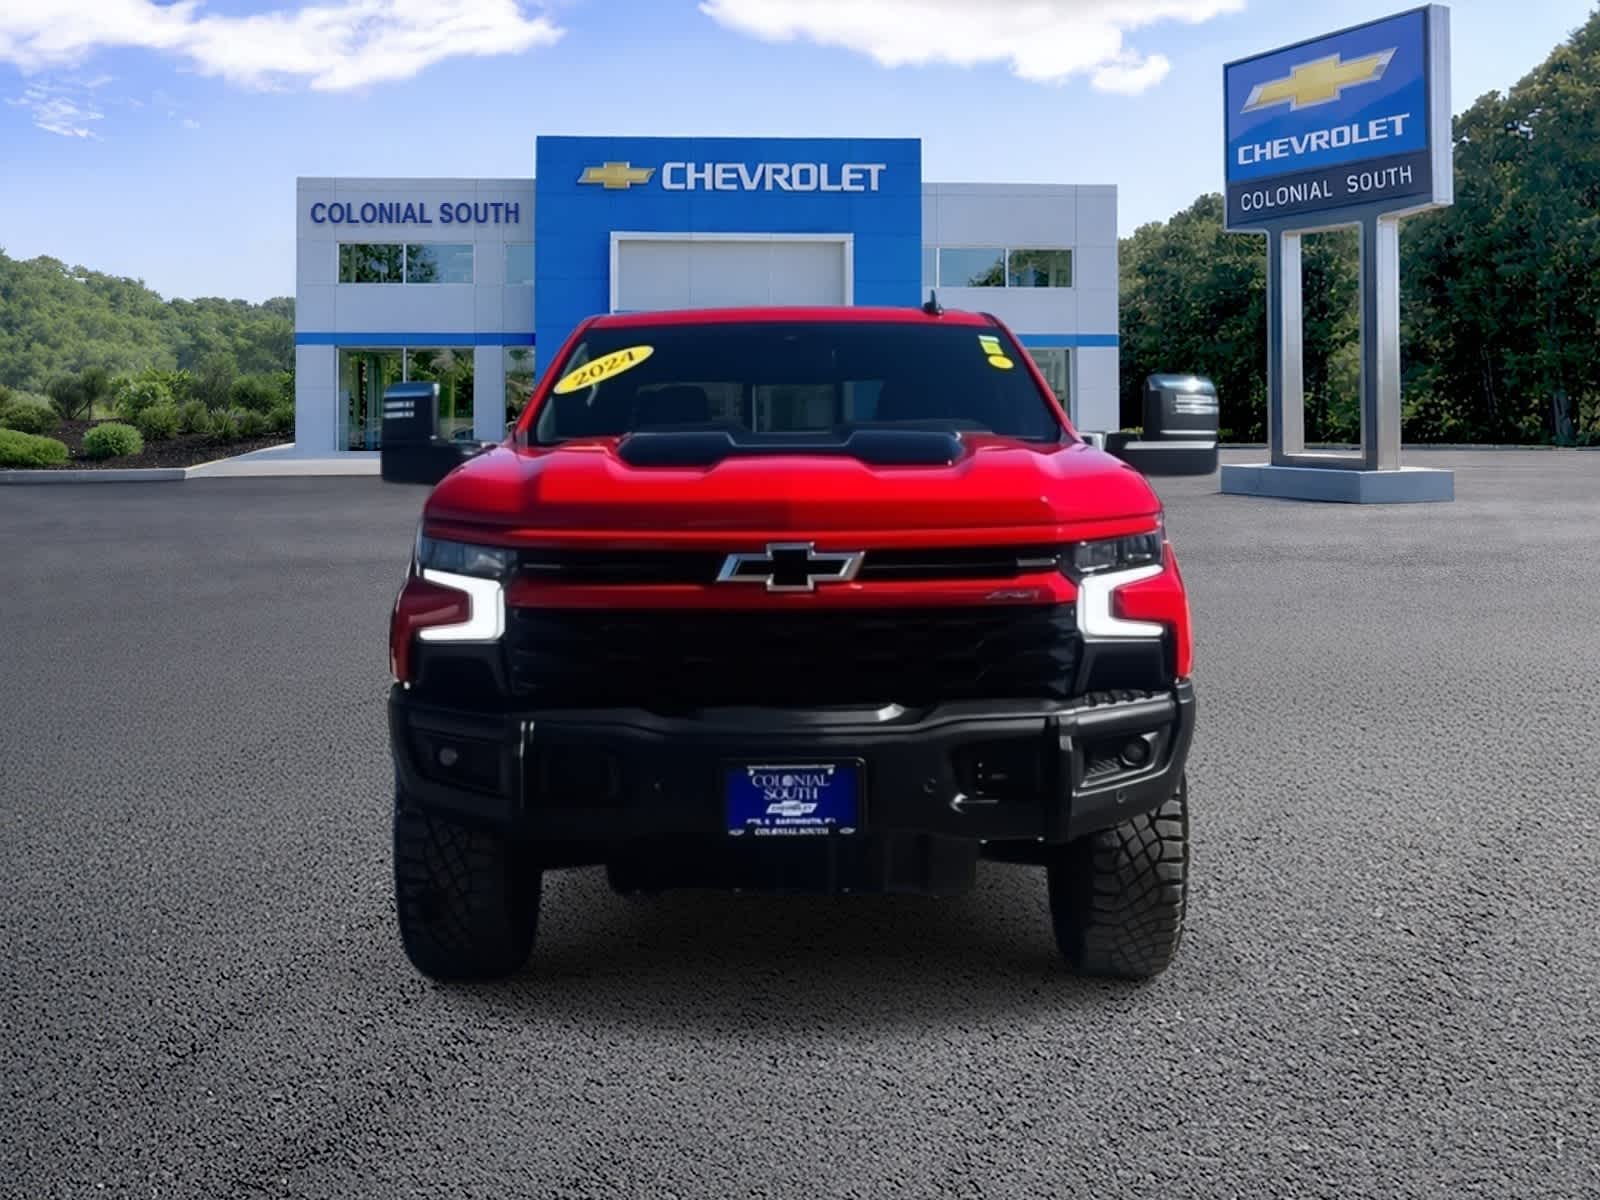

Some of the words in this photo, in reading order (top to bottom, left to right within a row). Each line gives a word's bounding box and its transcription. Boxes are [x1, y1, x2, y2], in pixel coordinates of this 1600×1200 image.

[1237, 113, 1410, 165] CHEVROLET
[662, 162, 887, 192] CHEVROLET
[1241, 179, 1333, 211] COLONIAL
[1346, 165, 1412, 194] SOUTH
[310, 202, 432, 224] COLONIAL
[439, 202, 520, 224] SOUTH
[573, 351, 634, 385] 2024
[764, 787, 818, 800] SOUTH
